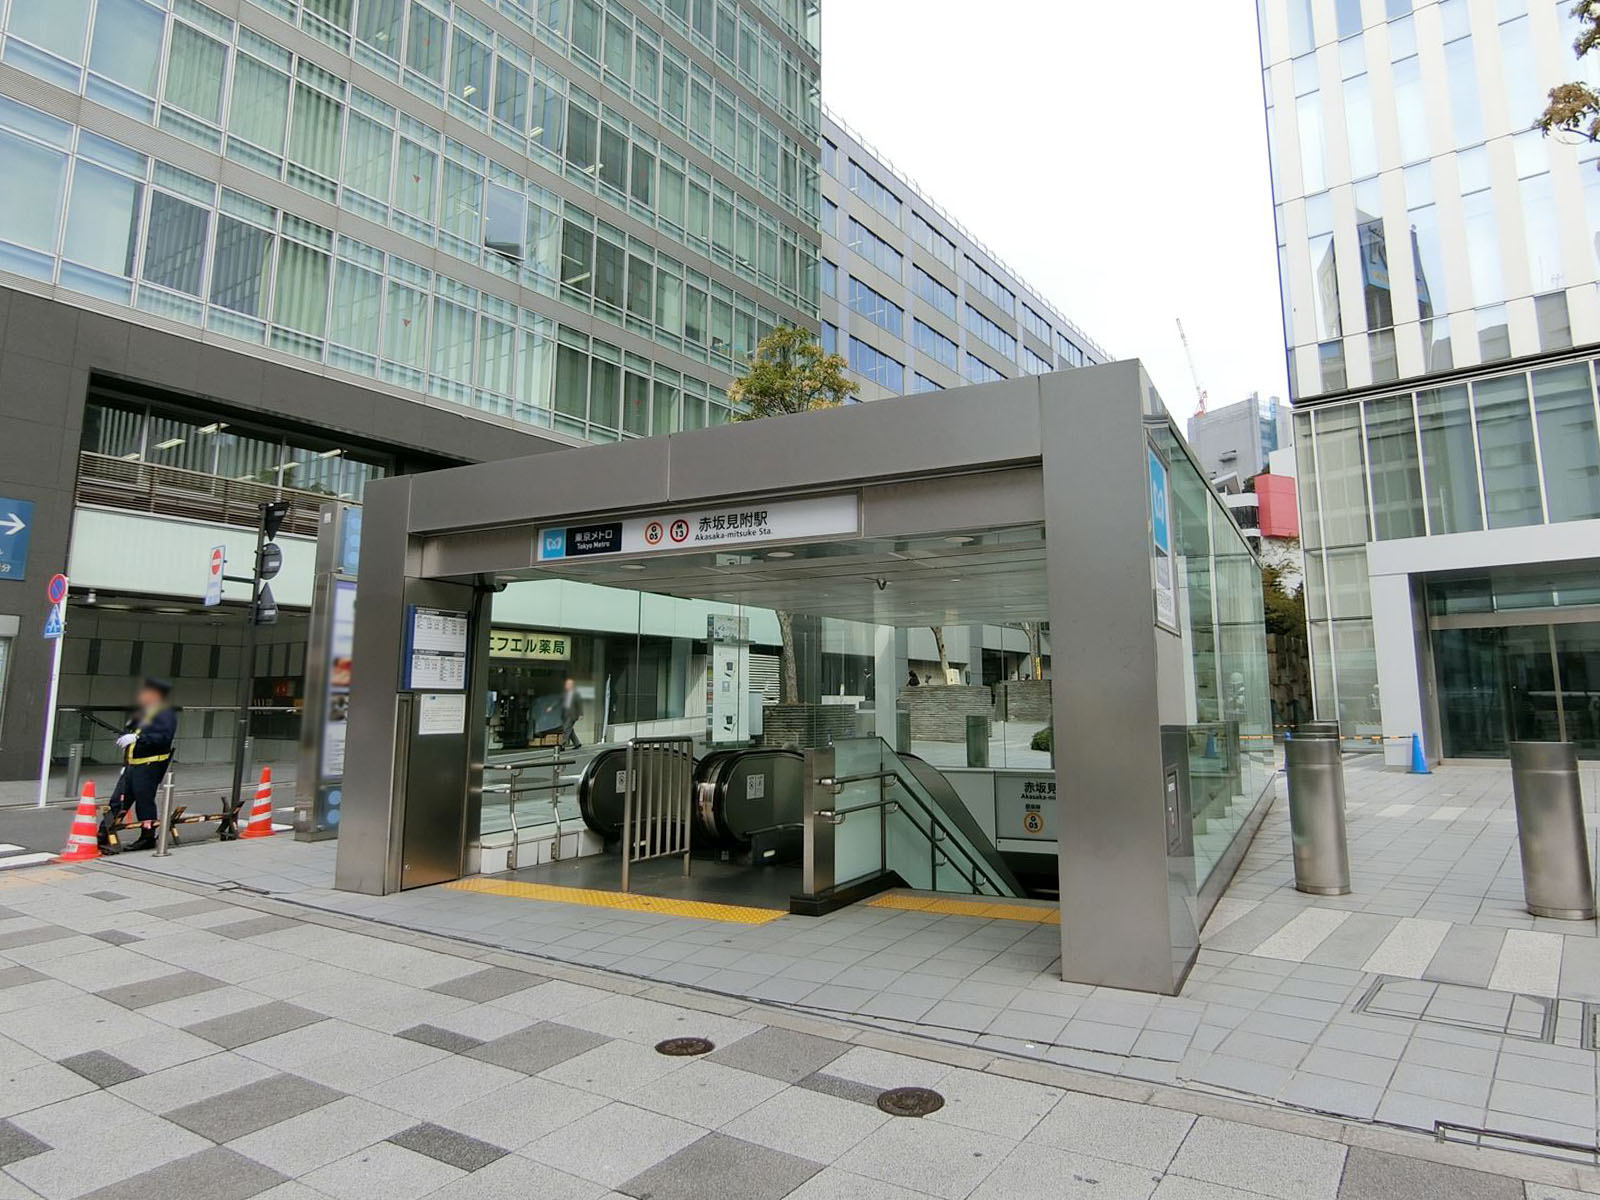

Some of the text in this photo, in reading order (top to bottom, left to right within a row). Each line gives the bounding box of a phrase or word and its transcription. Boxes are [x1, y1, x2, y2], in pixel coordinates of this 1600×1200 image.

[699, 511, 768, 532] 赤坂見附駅
[575, 530, 613, 542] 東京メトロ
[675, 530, 683, 538] 13
[695, 529, 757, 541] Akasaka-mitsuke
